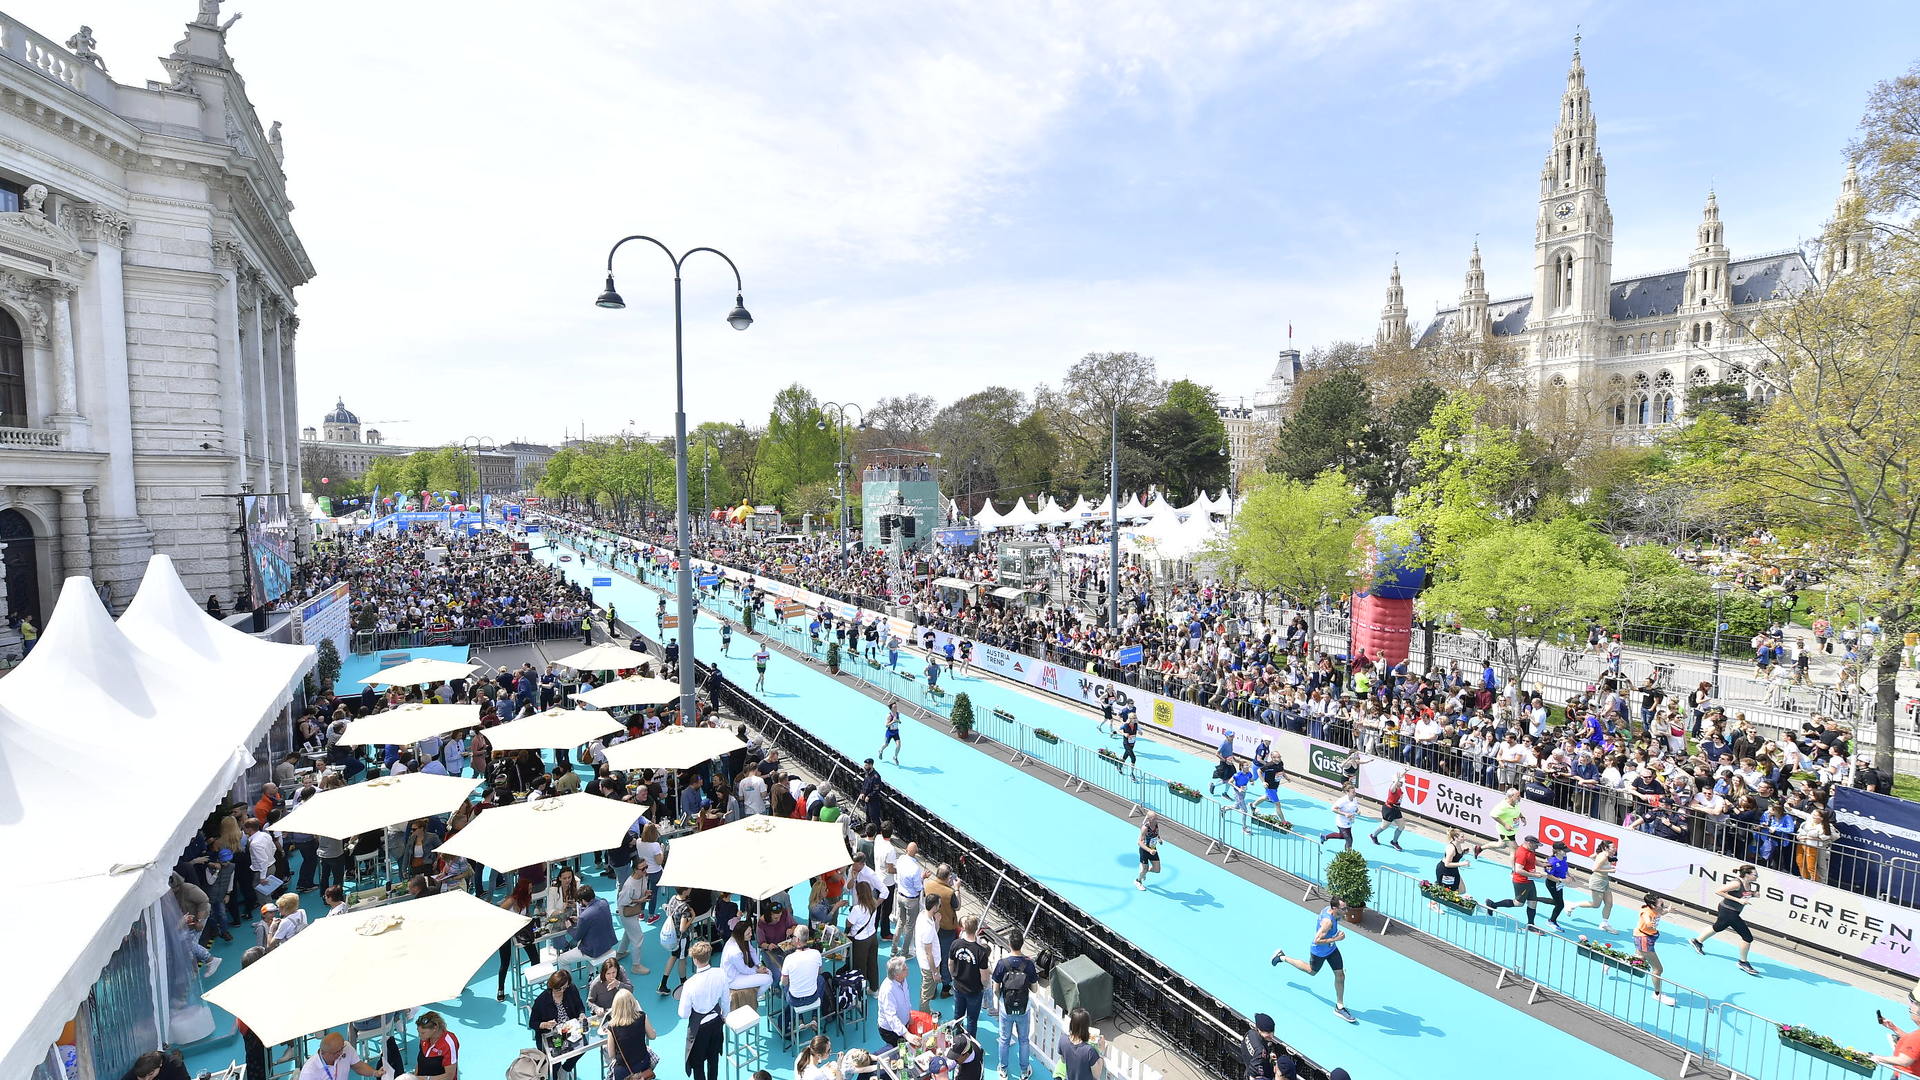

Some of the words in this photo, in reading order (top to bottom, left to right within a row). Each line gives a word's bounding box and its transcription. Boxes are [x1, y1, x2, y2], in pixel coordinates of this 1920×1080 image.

[986, 648, 1011, 661] AUSTRIA
[986, 655, 1005, 667] TREND
[1094, 684, 1128, 707] GD
[1206, 723, 1264, 745] WIE.INF
[1312, 750, 1343, 774] Göss
[1437, 783, 1483, 809] Stadt
[1526, 786, 1545, 796] POLIZEI
[1436, 798, 1482, 825] Wien
[1853, 836, 1872, 845] CITY
[1872, 841, 1919, 858] MARATHON
[1788, 909, 1829, 930] DEIN
[1837, 922, 1912, 955] ÖFFI-TV
